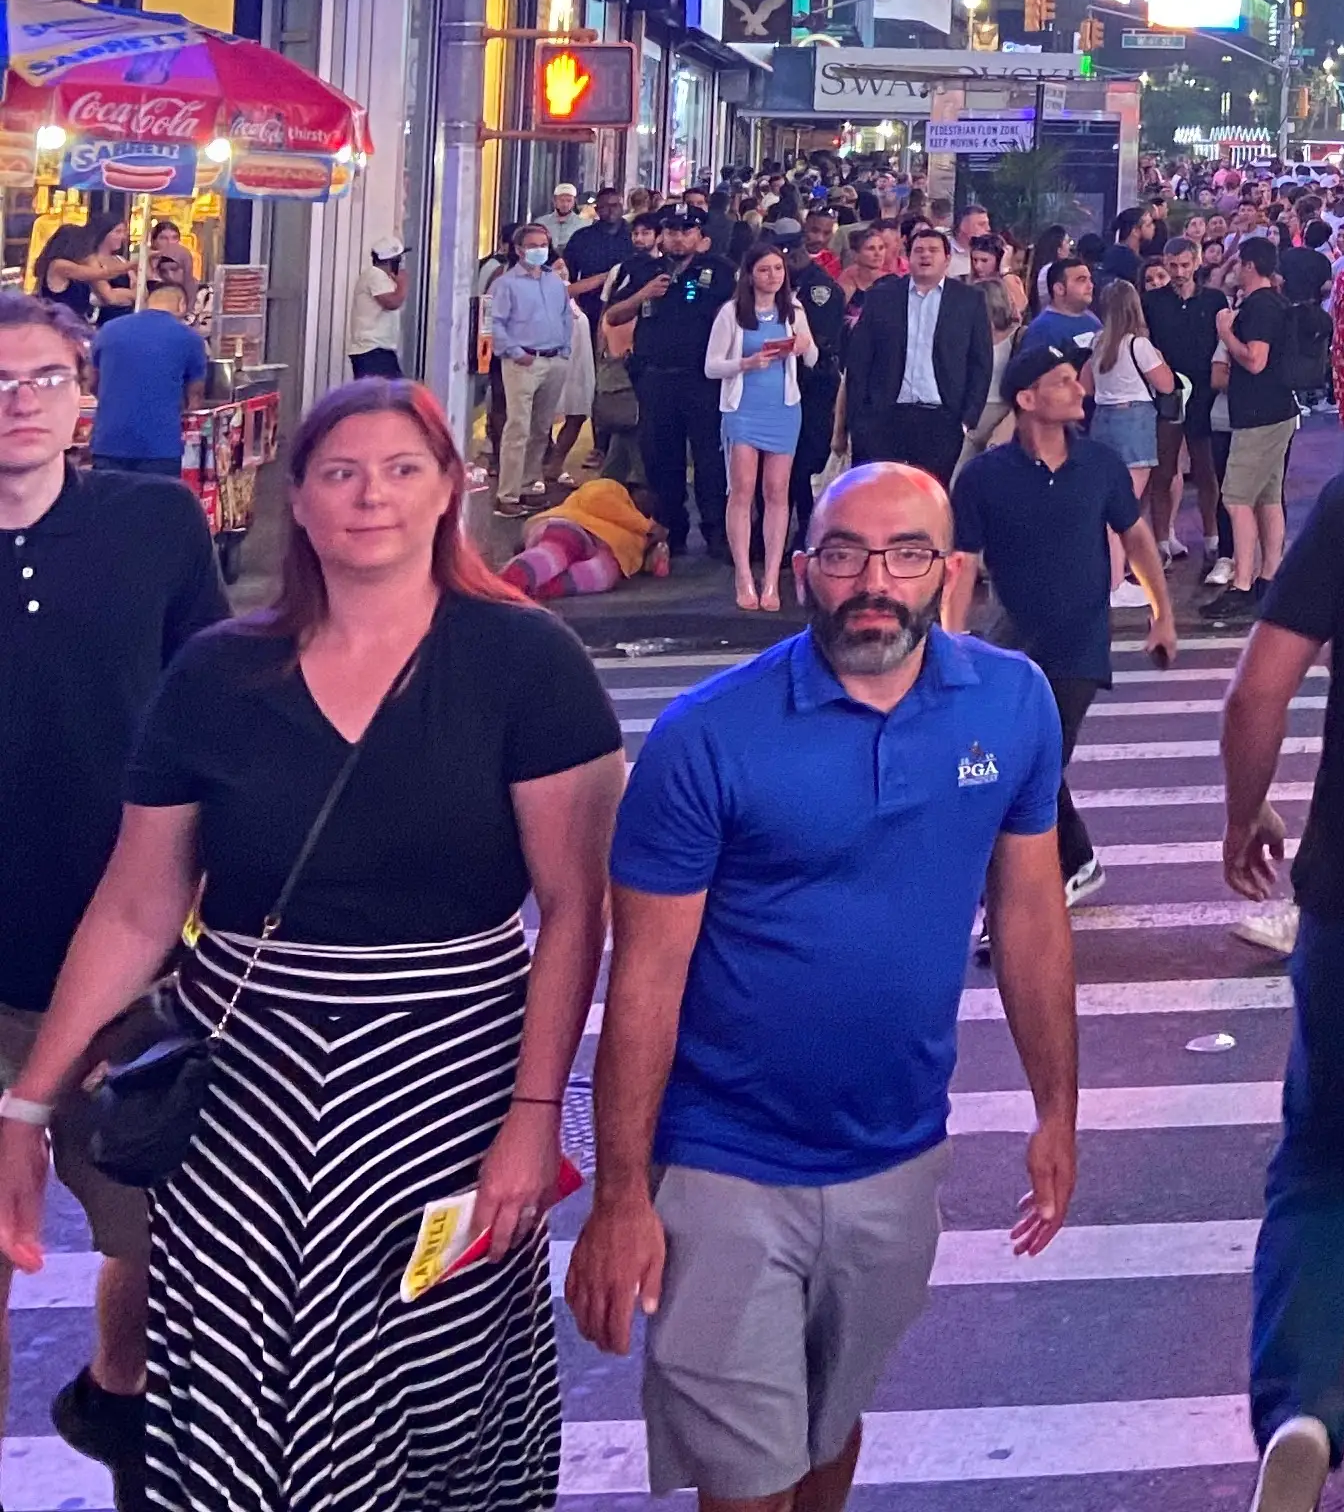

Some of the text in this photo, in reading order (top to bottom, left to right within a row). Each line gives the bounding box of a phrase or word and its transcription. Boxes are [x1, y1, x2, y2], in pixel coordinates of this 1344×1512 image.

[821, 62, 1077, 99] SWAOVSKI
[68, 91, 208, 138] Coca-Cola
[958, 760, 999, 780] PGA
